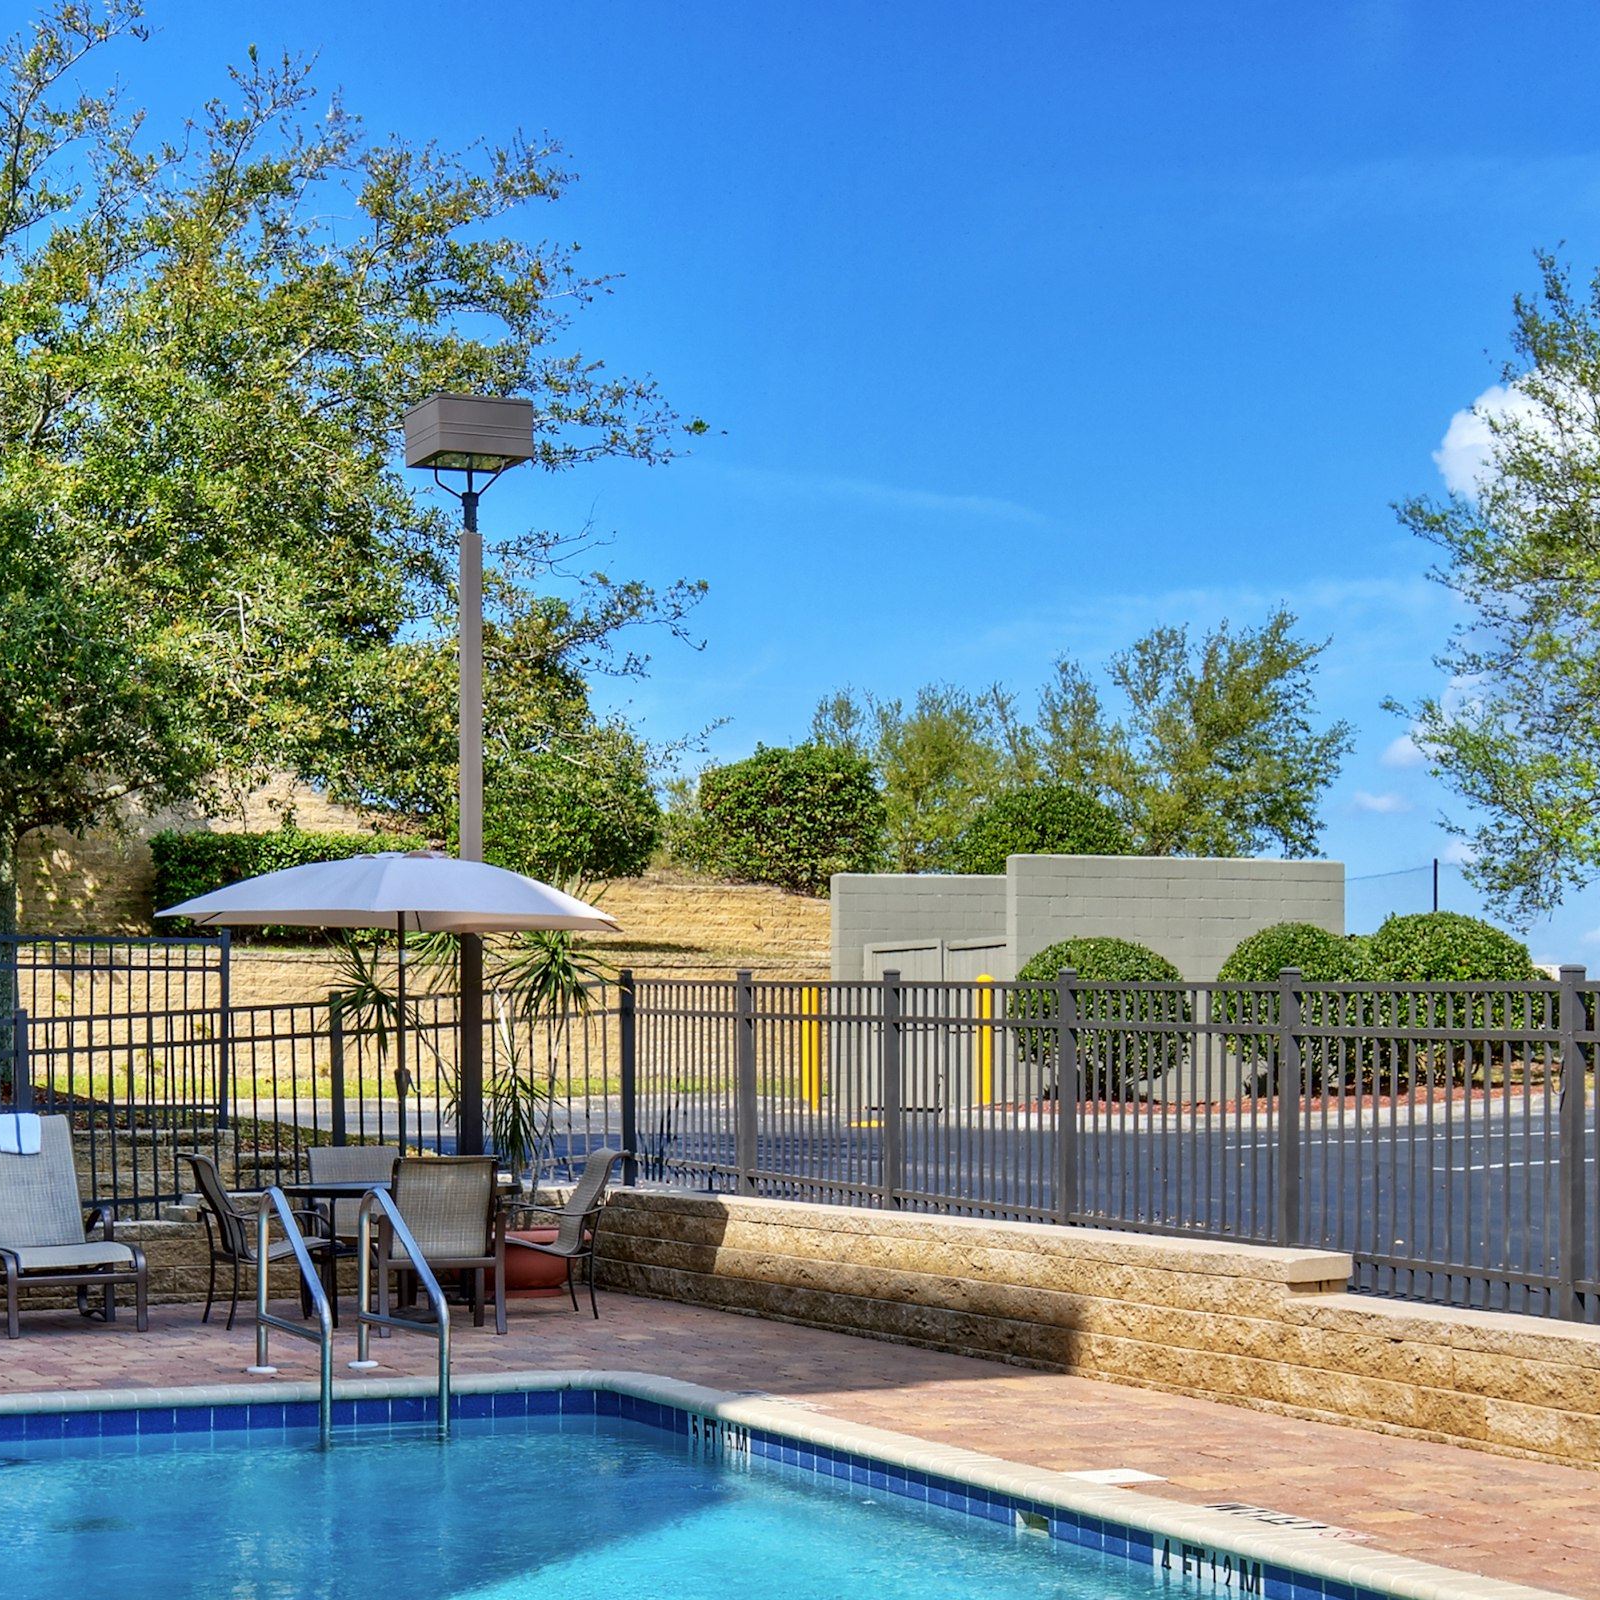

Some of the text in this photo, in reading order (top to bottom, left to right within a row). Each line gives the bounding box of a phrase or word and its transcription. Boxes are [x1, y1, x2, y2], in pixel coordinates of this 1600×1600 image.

[704, 1418, 717, 1444] FT
[735, 1426, 747, 1452] M
[1161, 1539, 1171, 1571] 4
[1182, 1544, 1205, 1579] FT
[1240, 1558, 1261, 1595] M
